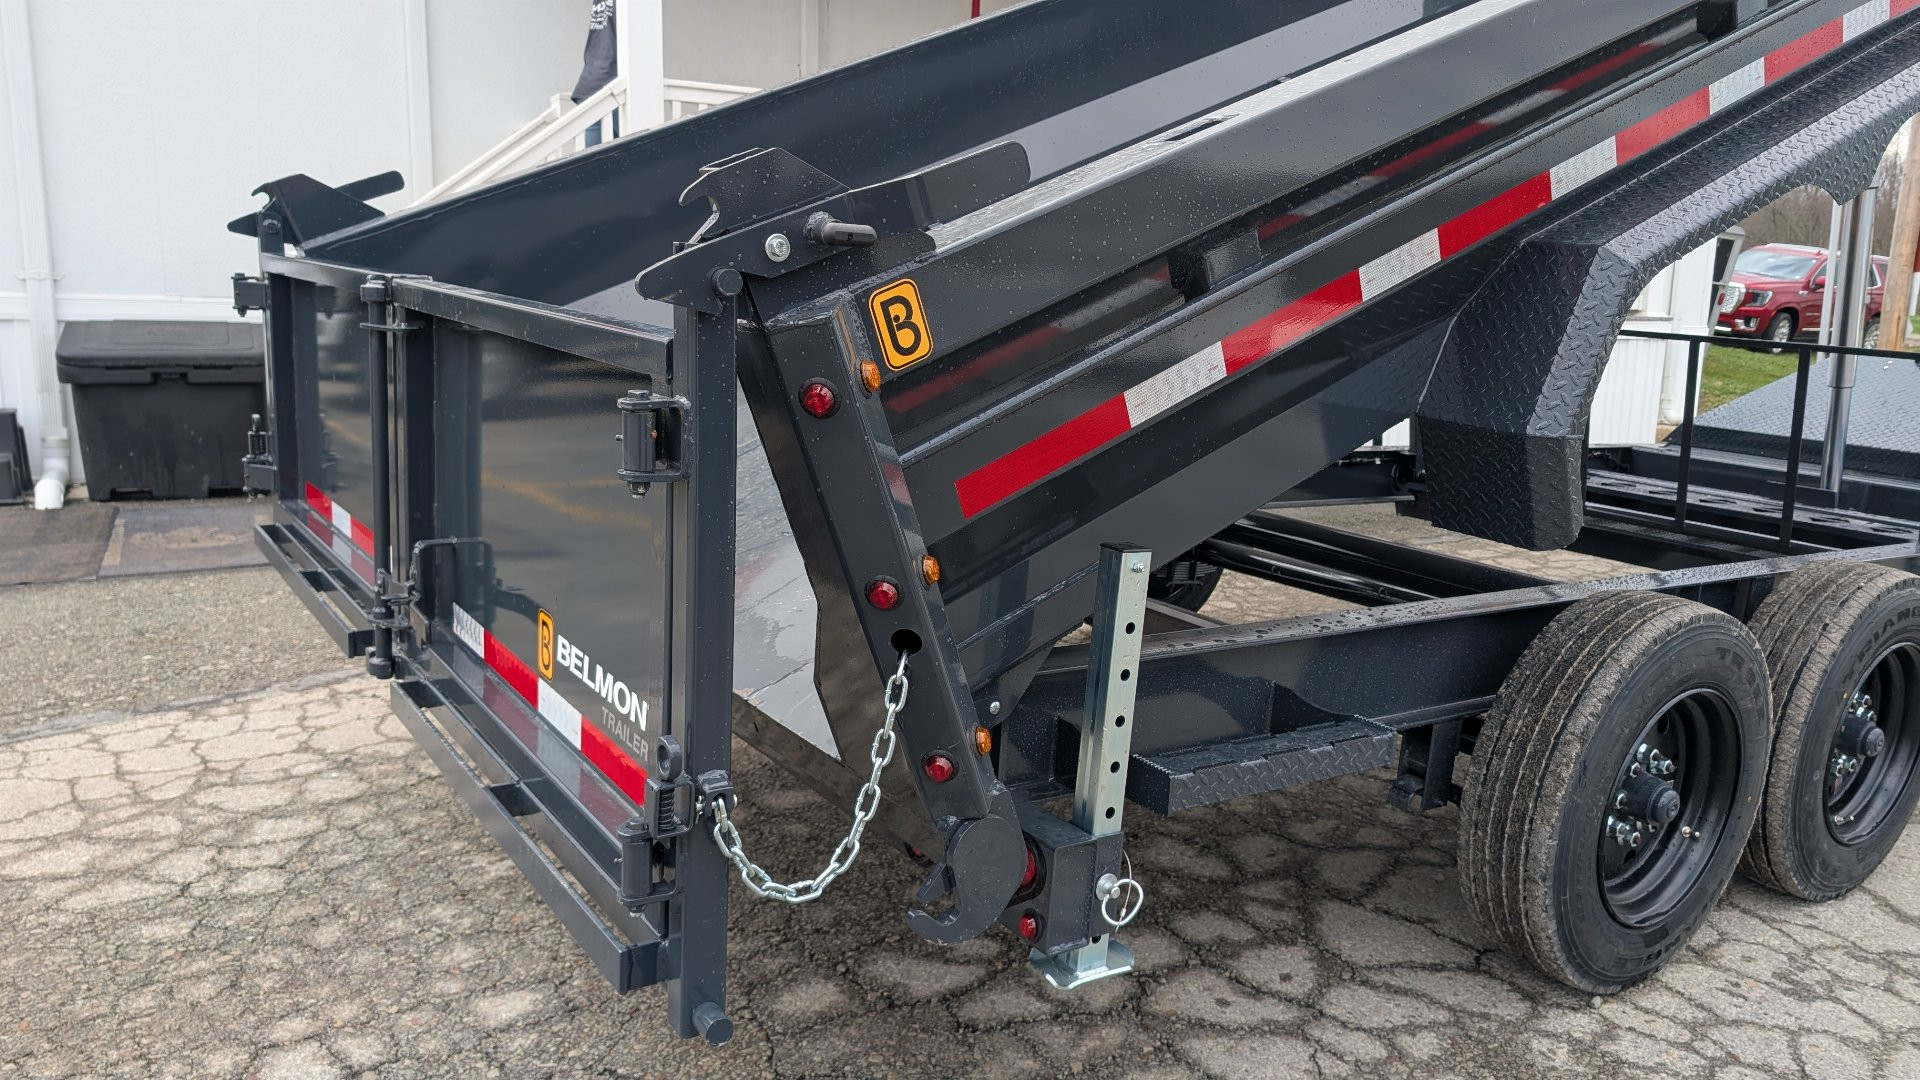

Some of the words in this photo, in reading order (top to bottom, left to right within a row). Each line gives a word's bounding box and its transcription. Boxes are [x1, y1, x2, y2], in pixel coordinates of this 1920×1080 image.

[880, 295, 921, 356] B
[556, 634, 648, 731] BELMON
[601, 705, 649, 762] TRAILER
